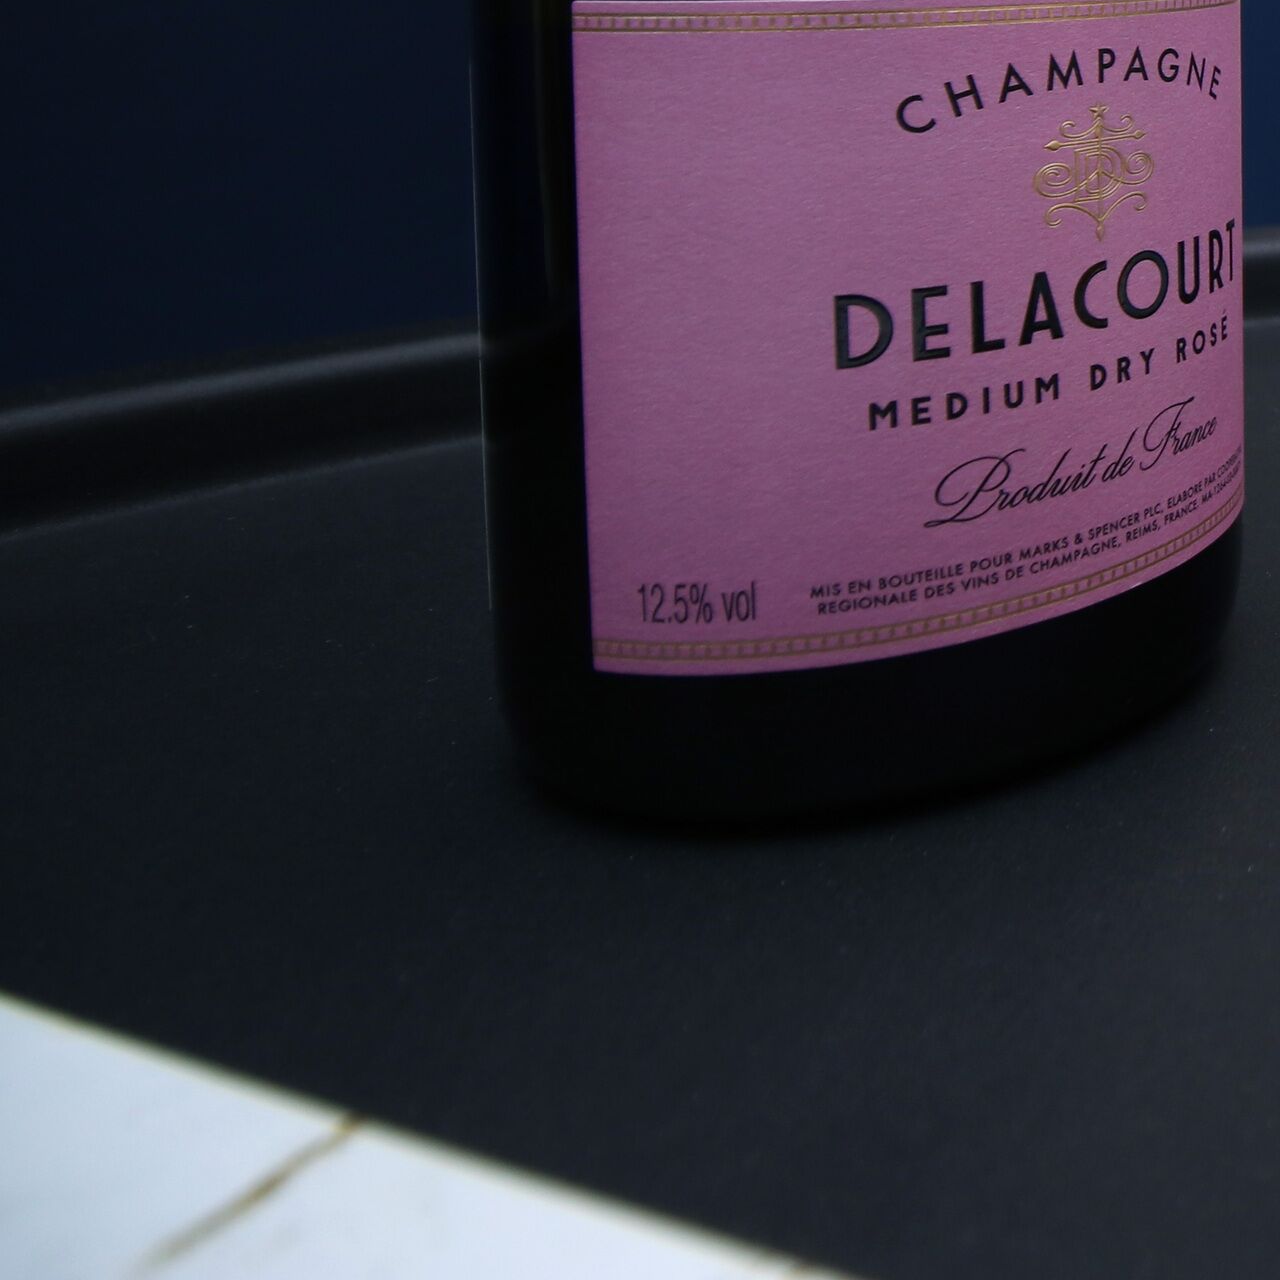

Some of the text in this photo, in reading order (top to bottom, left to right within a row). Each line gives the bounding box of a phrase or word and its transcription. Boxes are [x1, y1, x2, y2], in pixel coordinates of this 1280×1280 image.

[896, 45, 1221, 133] CHAMPAGNE
[834, 219, 1235, 370] DELACOURT
[868, 310, 1228, 431] MEDIUM DRY ROSÉ
[923, 443, 1107, 528] Produit
[1102, 427, 1138, 482] de
[1139, 396, 1217, 471] France
[810, 582, 841, 598] MIS
[848, 578, 871, 594] EN
[878, 562, 964, 590] BOUTEILLE
[970, 552, 1013, 573] POUR
[1019, 536, 1068, 561] MARKS
[1074, 532, 1083, 545] &
[1088, 512, 1141, 540] SPENCER
[818, 592, 918, 615] REGIONALE
[924, 581, 955, 599] DES
[962, 572, 999, 591] VINS
[1005, 566, 1025, 580] DE
[638, 580, 756, 624] 12.5% vol
